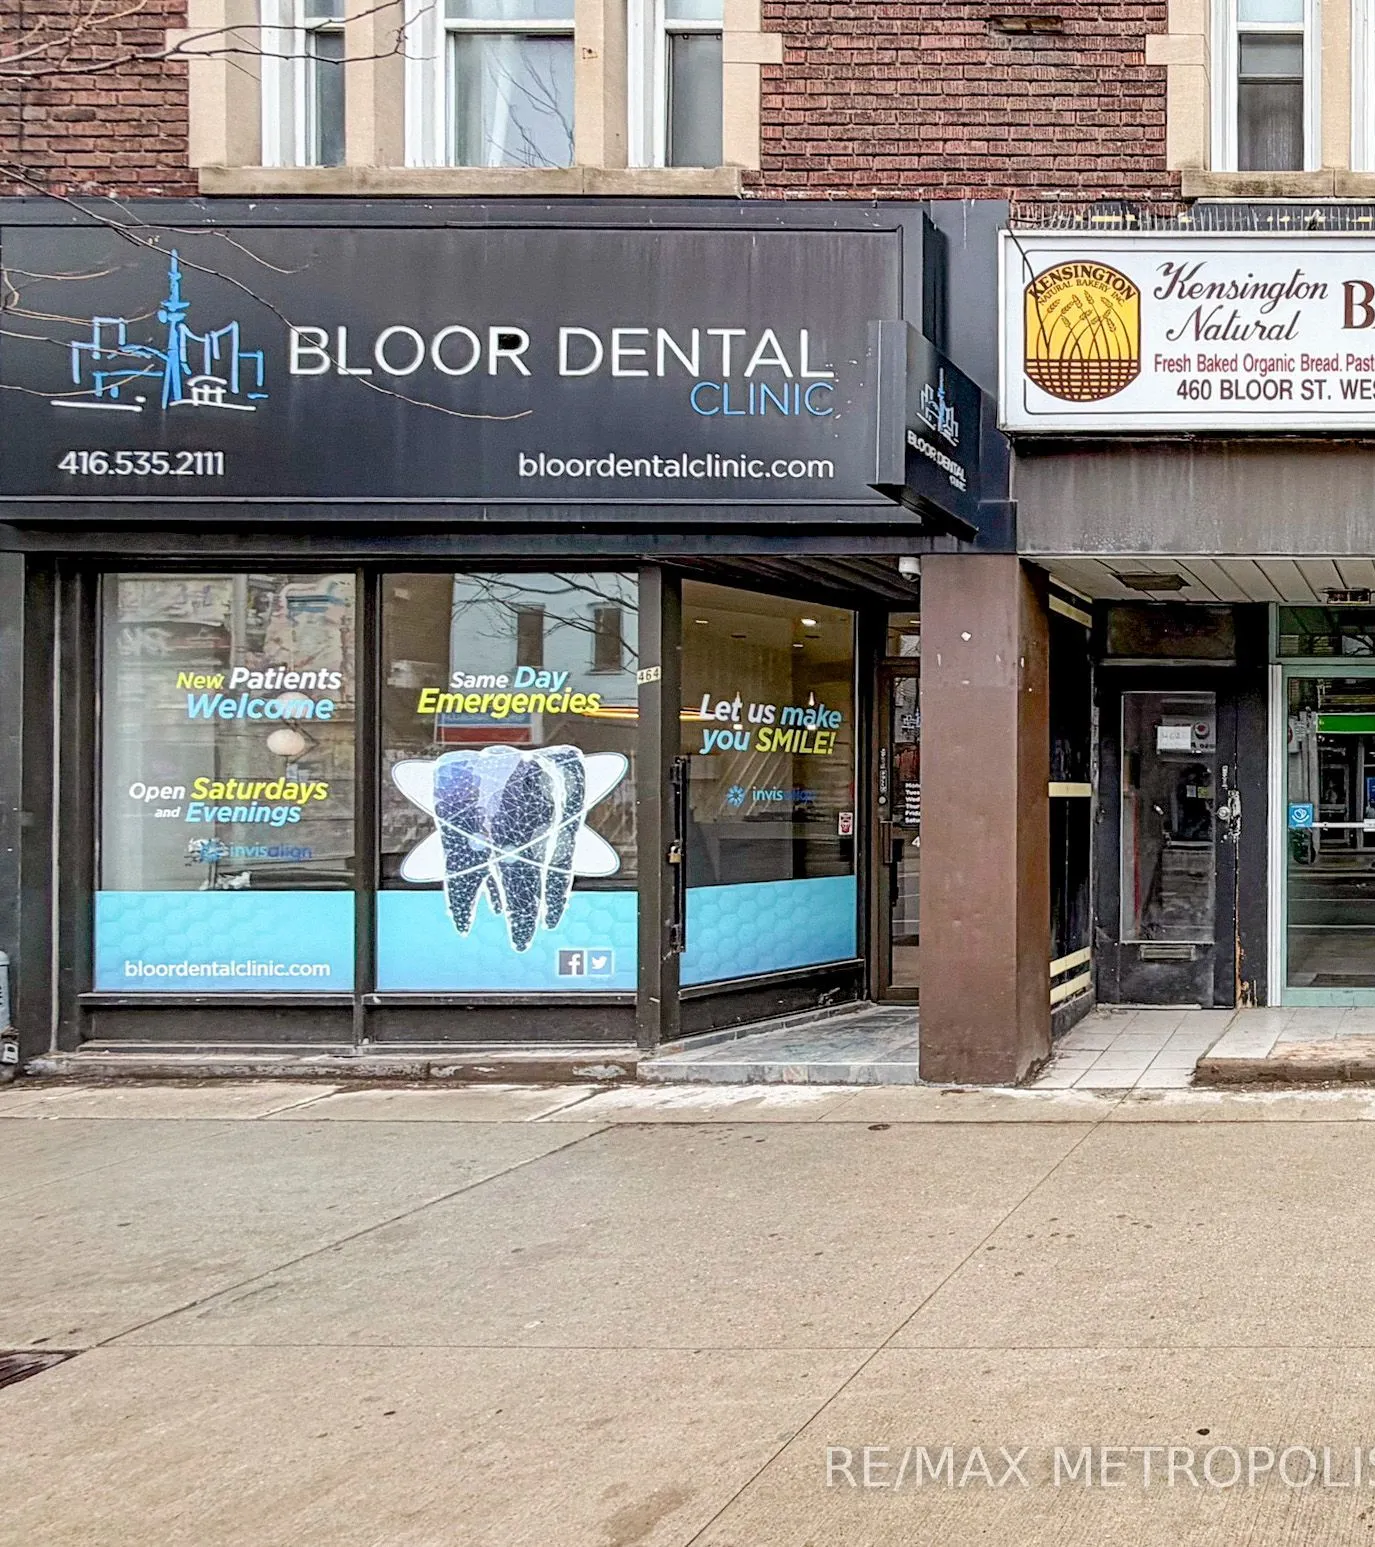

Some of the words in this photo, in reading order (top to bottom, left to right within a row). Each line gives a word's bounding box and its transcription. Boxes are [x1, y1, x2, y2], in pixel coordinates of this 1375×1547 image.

[1028, 264, 1137, 301] KENSINGTON
[1037, 280, 1073, 306] NATURAL
[1076, 278, 1111, 293] BAKERY
[1154, 260, 1328, 315] Kensington
[1166, 304, 1301, 342] Natural
[288, 325, 532, 377] BLOOR
[557, 325, 836, 378] DENTAL
[1154, 353, 1191, 373] Fresh
[1199, 353, 1238, 373] Baked
[1243, 353, 1295, 376] Organic
[1300, 353, 1343, 373] Bread.
[690, 382, 834, 416] CLINIC
[1176, 379, 1213, 400] 460
[1220, 379, 1293, 401] BLOOR
[1300, 379, 1331, 400] ST.
[57, 450, 226, 477] 416.535.2111
[518, 453, 834, 478] bloordentalclinic.com
[907, 430, 936, 461] BLOOR
[936, 451, 967, 482] DENTAL
[175, 671, 225, 689] New
[229, 667, 343, 690] Patients
[449, 671, 509, 689] Same
[513, 666, 569, 692] Day
[639, 669, 660, 682] 464
[185, 693, 335, 720] Welcome
[416, 687, 601, 718] Emergencies
[699, 694, 742, 722] Let
[748, 704, 776, 723] us
[781, 704, 843, 729] make
[700, 729, 751, 755] you
[755, 727, 837, 755] SMILE!
[129, 782, 185, 802] Open
[191, 777, 328, 804] Saturdays
[154, 806, 181, 818] and
[185, 802, 301, 827] Evenings
[124, 960, 330, 977] bloordentalclinic.com
